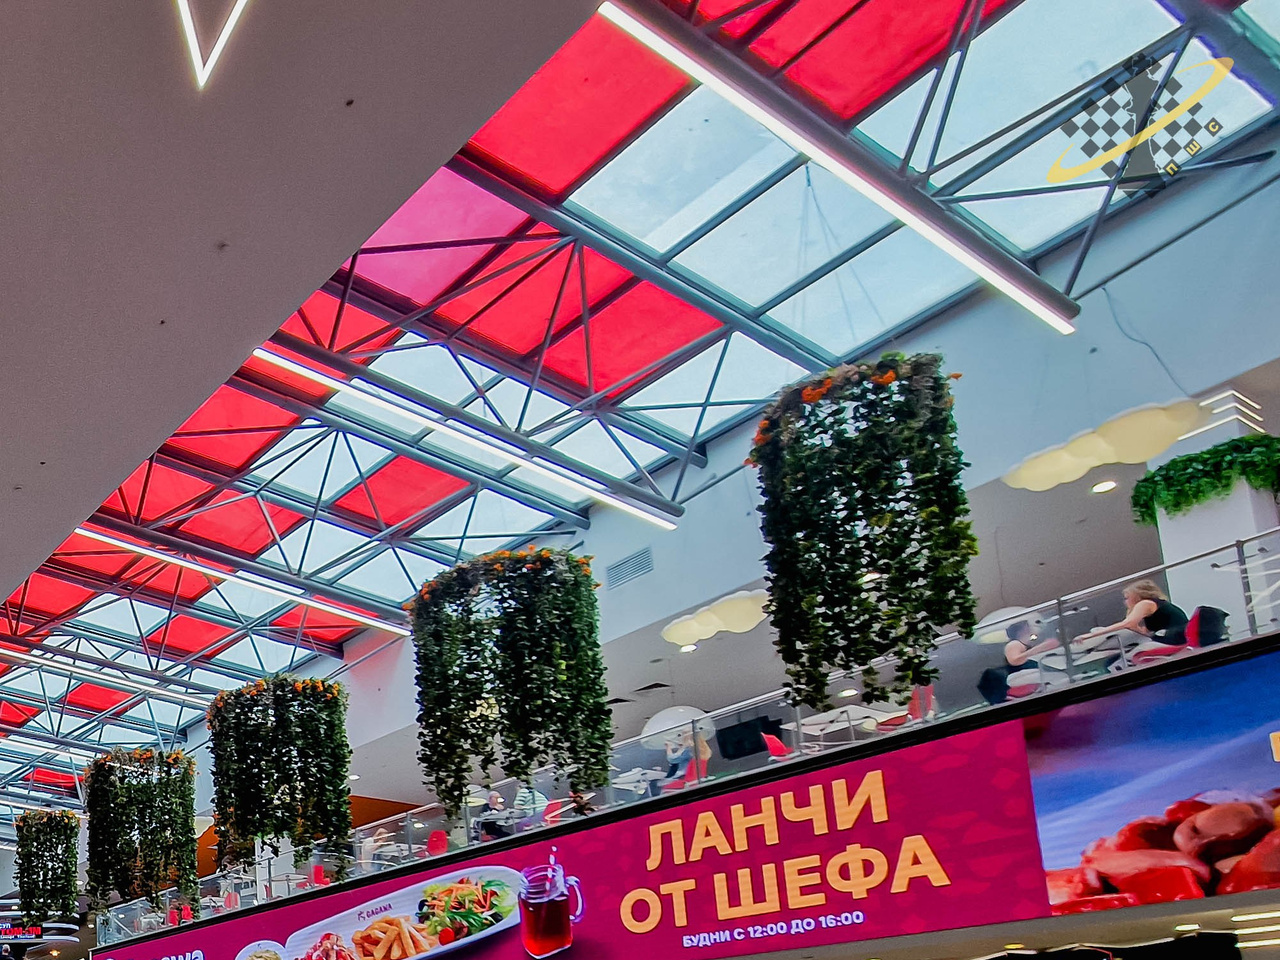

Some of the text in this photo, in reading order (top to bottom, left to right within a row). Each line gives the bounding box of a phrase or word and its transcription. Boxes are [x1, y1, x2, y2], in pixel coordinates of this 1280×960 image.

[646, 769, 888, 871] ЛАНЧИ
[619, 834, 952, 934] ОТ ШЕФА
[682, 910, 865, 948] БУДНИ С 12:00 ДО 16:00
